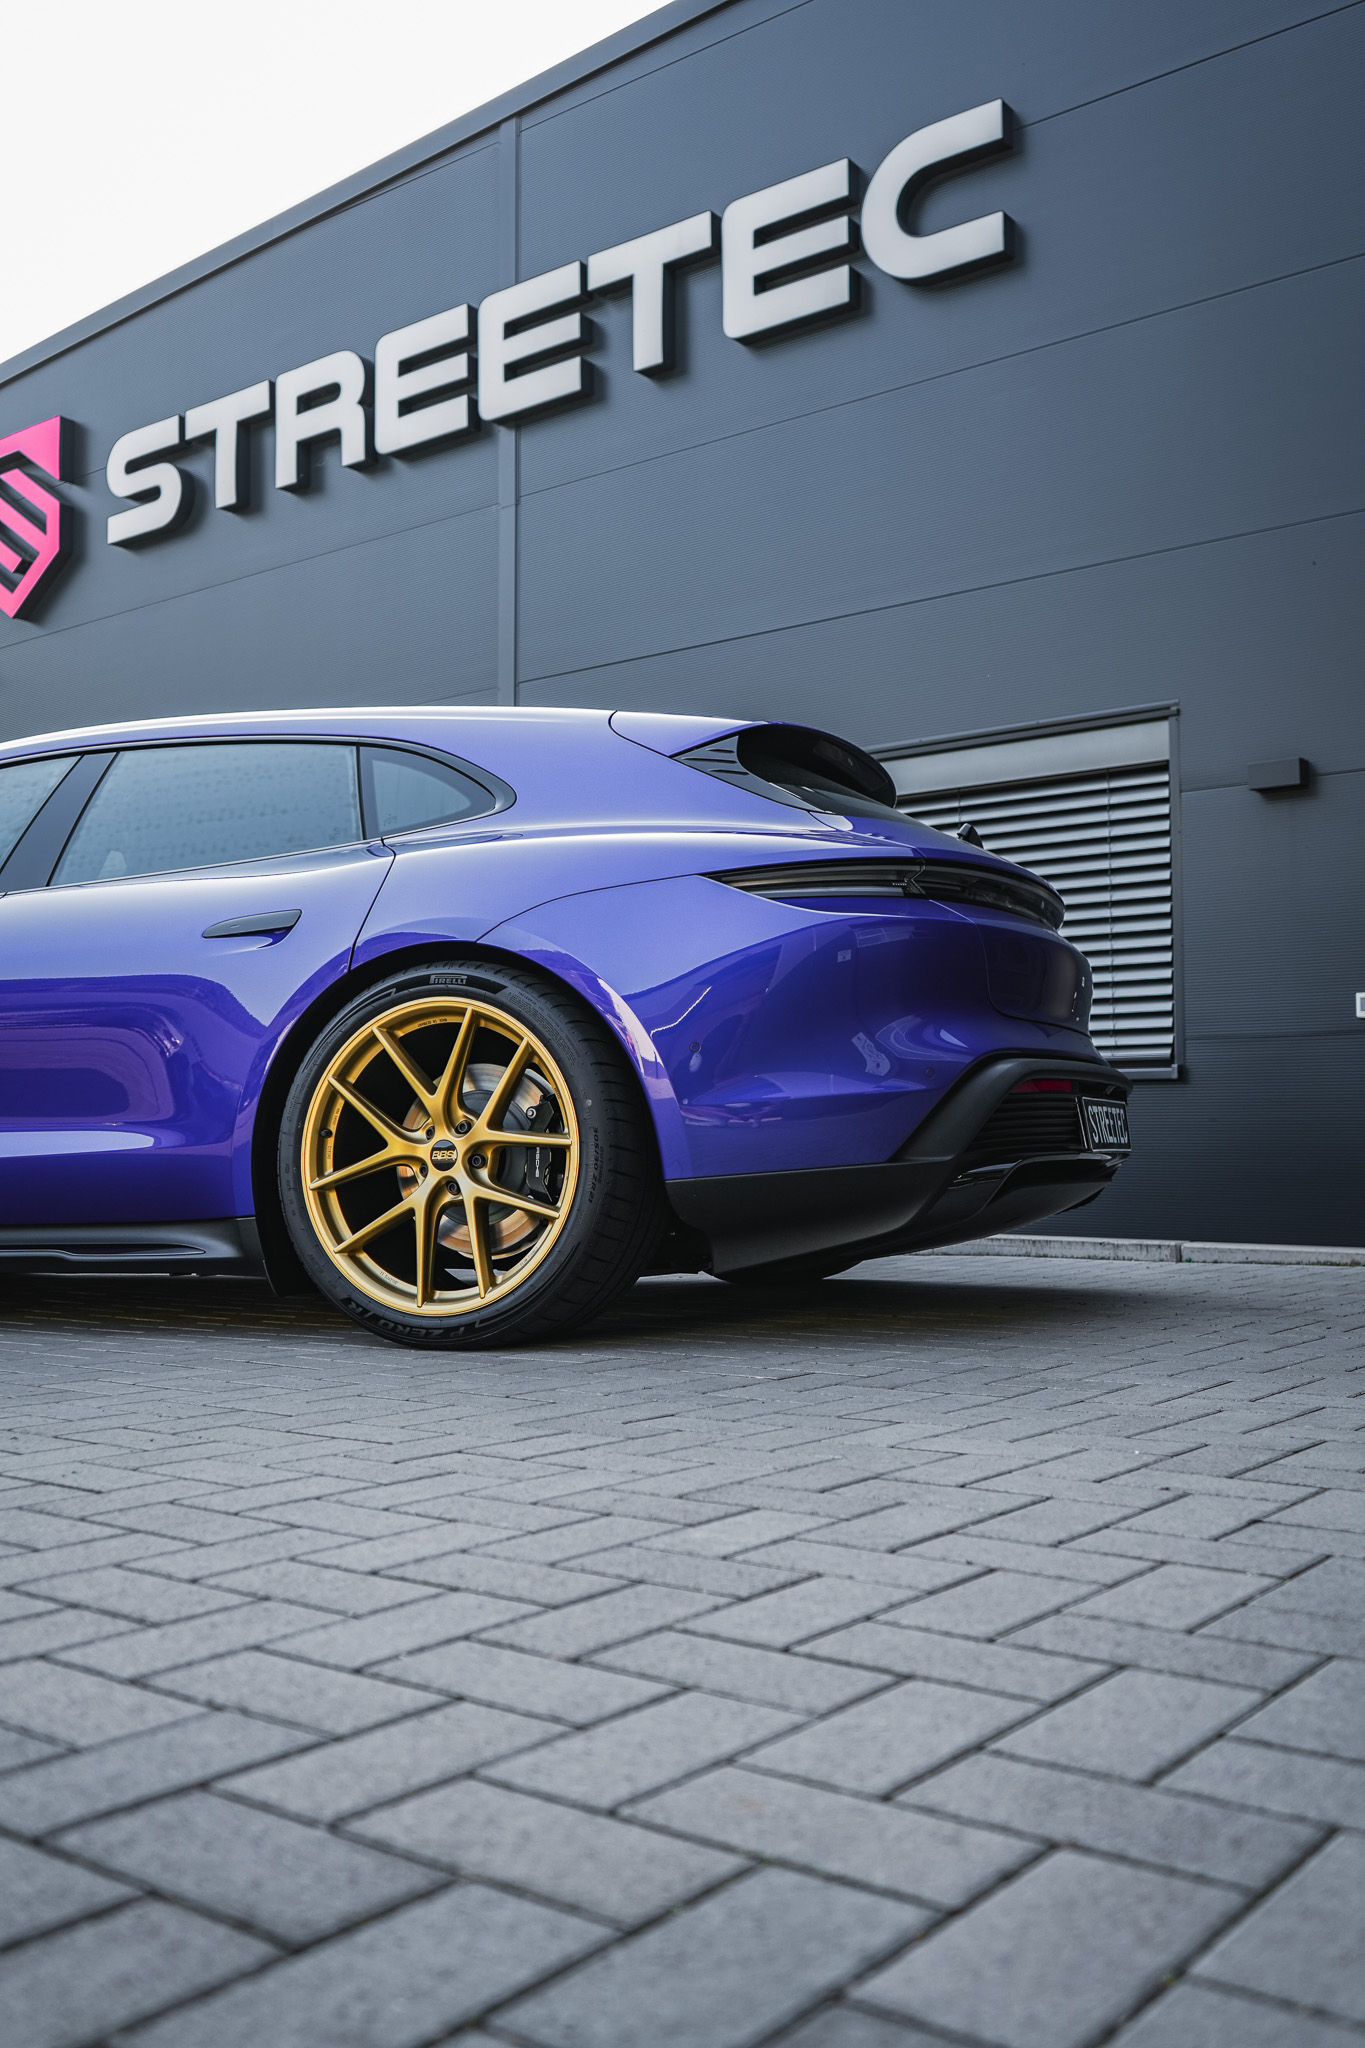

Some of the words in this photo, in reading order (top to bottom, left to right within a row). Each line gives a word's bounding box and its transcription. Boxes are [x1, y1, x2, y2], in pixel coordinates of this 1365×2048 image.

[105, 98, 1006, 545] STREETEC
[430, 974, 468, 985] PIRELLI
[1087, 1105, 1128, 1144] STREETEC
[432, 1150, 454, 1161] BBS
[592, 1126, 600, 1171] 305/30
[588, 1172, 599, 1204] ZR21
[378, 1318, 445, 1338] ZERO
[449, 1326, 465, 1338] P
